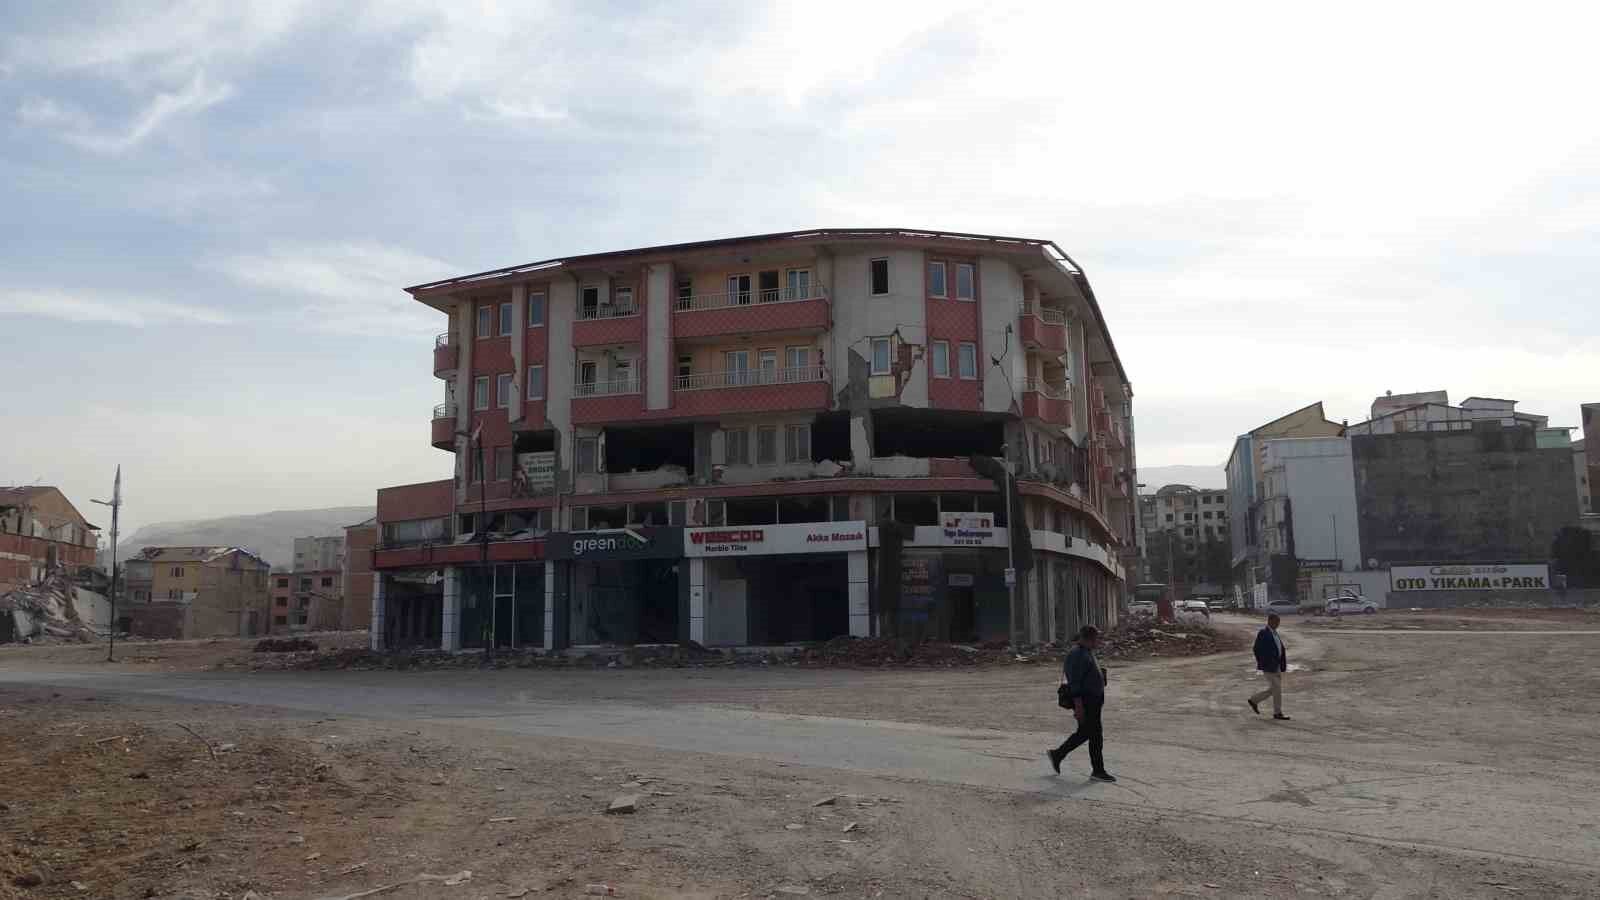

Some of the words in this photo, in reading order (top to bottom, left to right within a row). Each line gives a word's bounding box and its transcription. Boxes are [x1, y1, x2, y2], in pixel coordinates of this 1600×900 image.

[1396, 577, 1426, 590] OTO
[1431, 576, 1491, 589] YIKAMA
[1502, 576, 1547, 589] PARK
